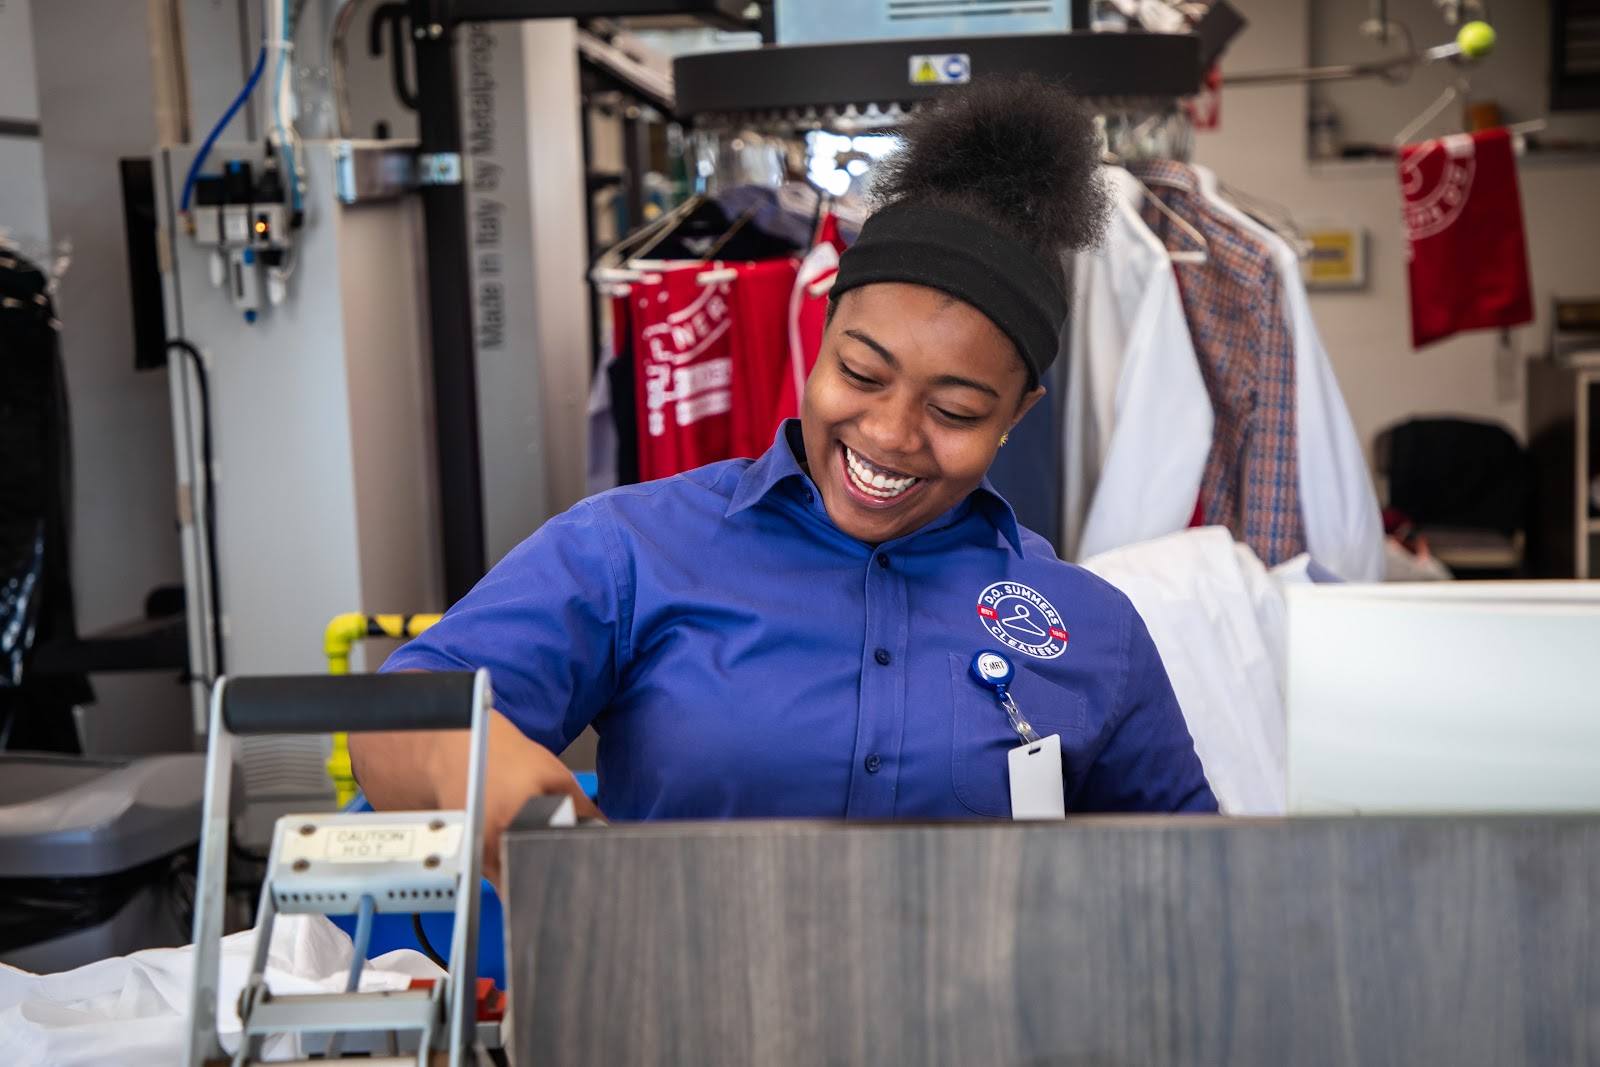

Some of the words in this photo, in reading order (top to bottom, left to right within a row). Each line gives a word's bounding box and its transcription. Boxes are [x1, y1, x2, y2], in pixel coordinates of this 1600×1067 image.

[474, 159, 504, 192] by
[475, 199, 506, 245] Italy
[479, 253, 503, 275] in
[479, 281, 505, 348] Made
[984, 588, 1003, 604] D.O.
[1004, 585, 1059, 625] SUMMERS
[991, 626, 1060, 656] CLEANERS
[336, 830, 405, 843] CAUTION
[342, 843, 383, 857] HOT
